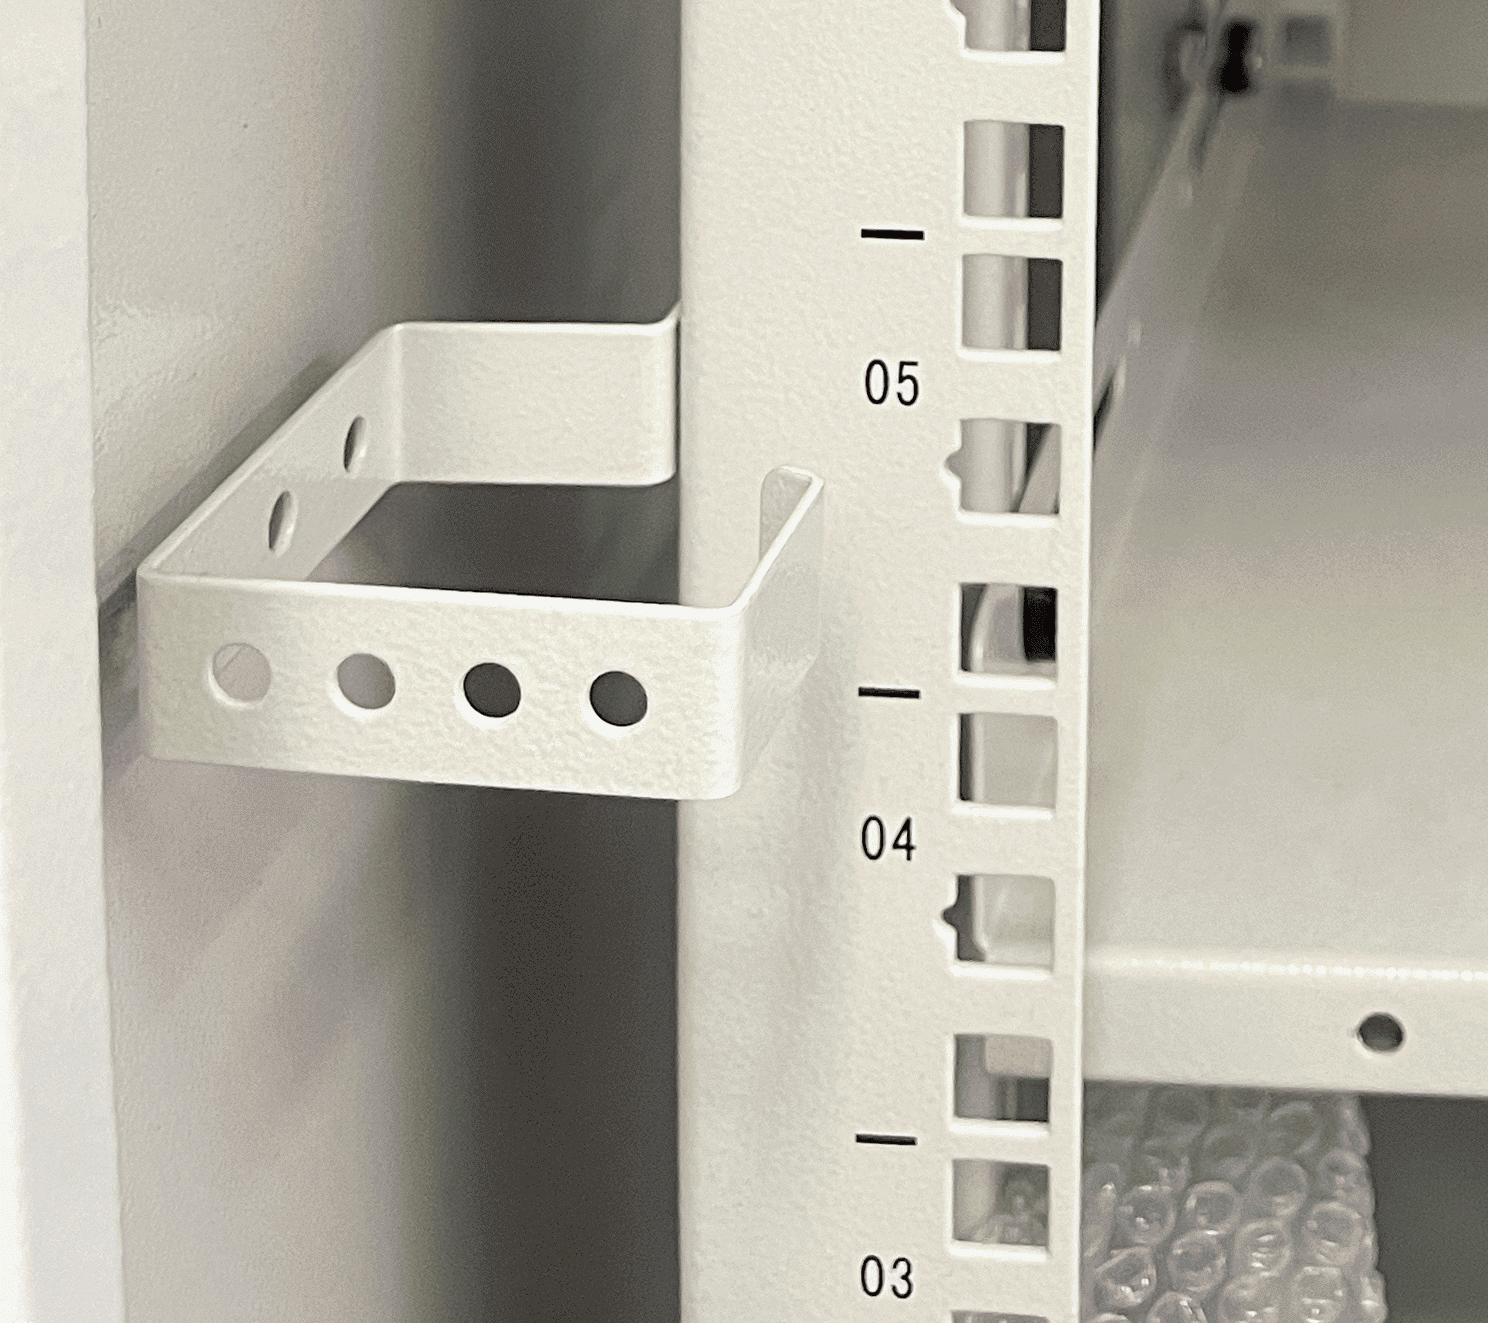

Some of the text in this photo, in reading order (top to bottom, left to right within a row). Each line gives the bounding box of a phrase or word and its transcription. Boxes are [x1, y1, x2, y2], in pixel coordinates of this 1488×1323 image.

[864, 358, 920, 407] 05
[860, 815, 916, 862] 04
[860, 1254, 914, 1300] 03
